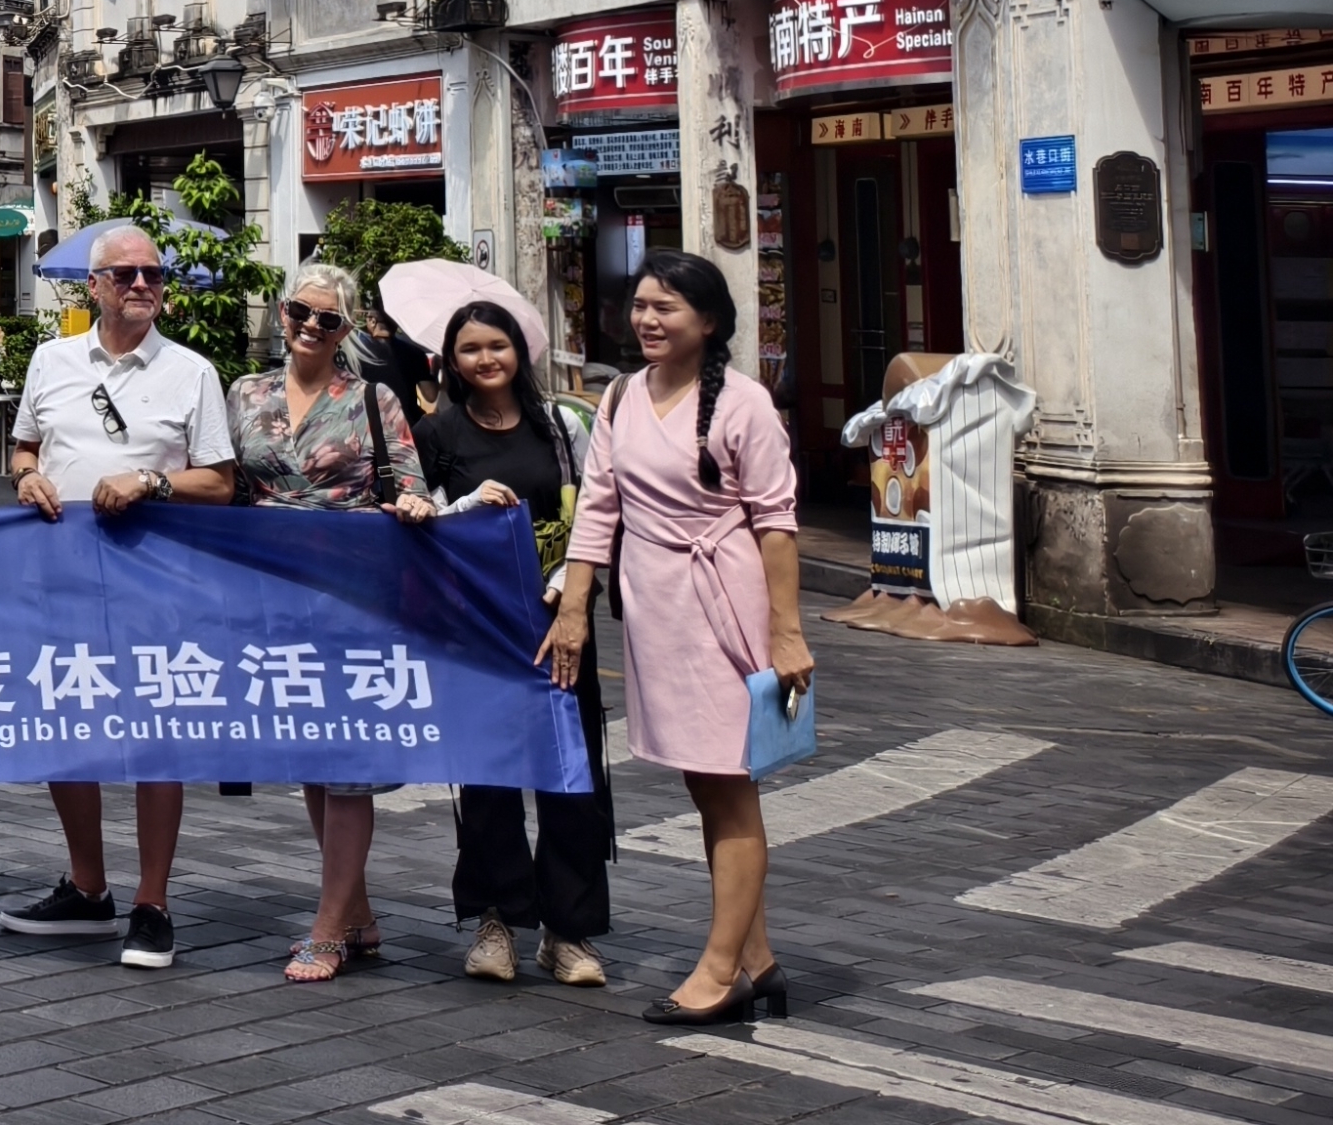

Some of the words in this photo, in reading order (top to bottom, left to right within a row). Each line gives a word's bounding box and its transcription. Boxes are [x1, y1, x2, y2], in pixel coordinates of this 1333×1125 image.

[895, 6, 943, 26] Hainan
[643, 37, 672, 52] Sou
[644, 66, 679, 85] 伴手
[834, 117, 863, 139] 海南
[102, 714, 261, 740] Cultural
[274, 715, 441, 748] Heritage
